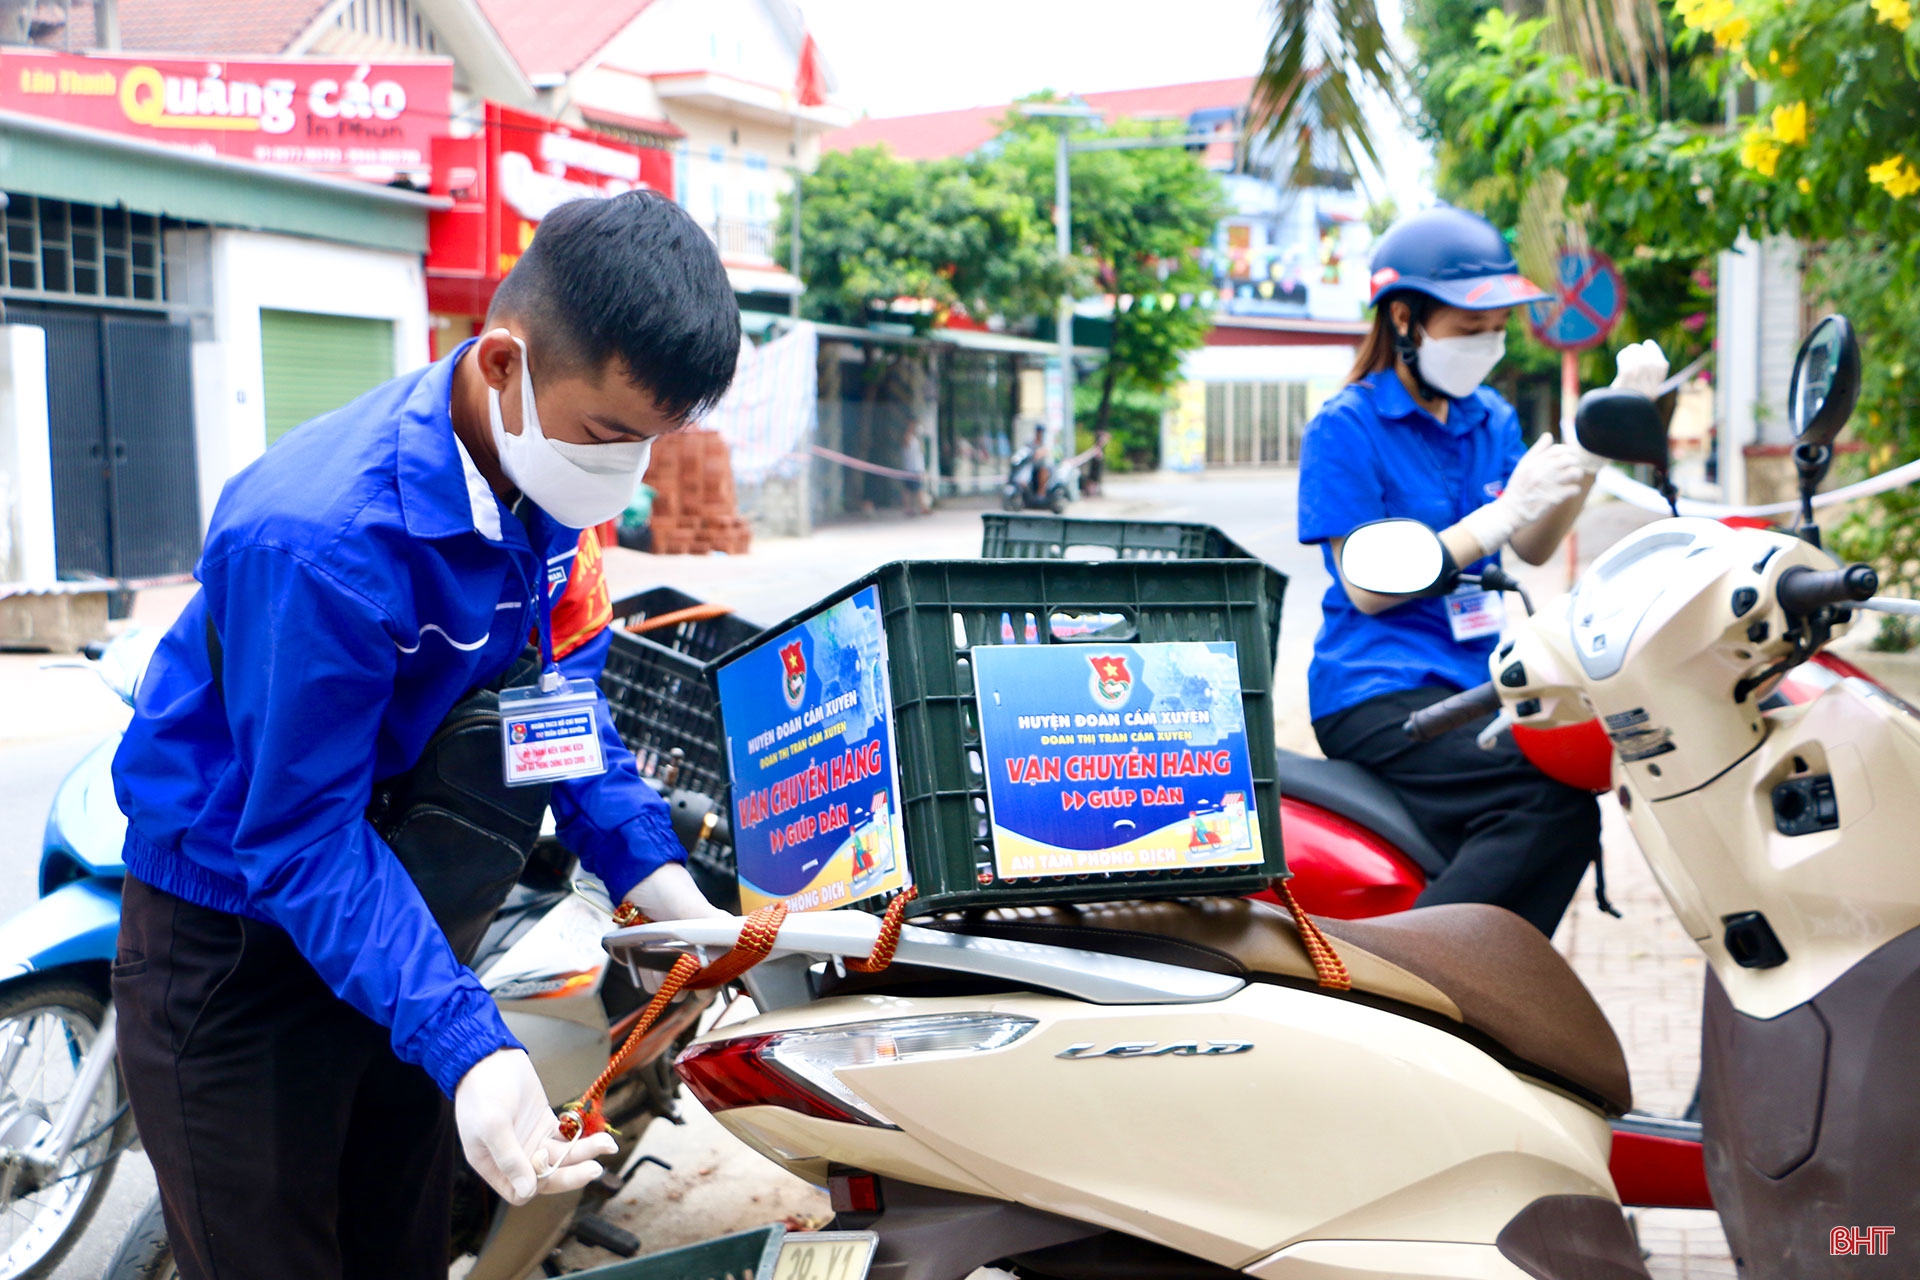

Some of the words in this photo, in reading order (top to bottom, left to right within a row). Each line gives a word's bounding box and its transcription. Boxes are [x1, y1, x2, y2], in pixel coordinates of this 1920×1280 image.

[120, 62, 296, 133] Quảng
[307, 62, 407, 120] cáo
[1018, 712, 1071, 731] HUYỆN
[1074, 711, 1121, 728] ĐOÀN
[1160, 708, 1211, 725] XUYÊN
[1006, 754, 1061, 786] VẬN
[1064, 746, 1157, 781] CHUYỂN
[1161, 749, 1231, 778] HÀNG
[738, 788, 770, 830] VẬN
[770, 757, 829, 816] CHUYỂN
[1087, 786, 1137, 808] GIÚP
[1141, 785, 1184, 806] DÂN
[785, 815, 817, 847] GIÚP
[818, 803, 849, 834] DÂN
[1011, 855, 1036, 871] AN
[1039, 852, 1074, 869] TÂM
[1139, 847, 1177, 865] DỊCH
[821, 880, 845, 906] DỊCH
[1055, 1039, 1255, 1059] LEAD
